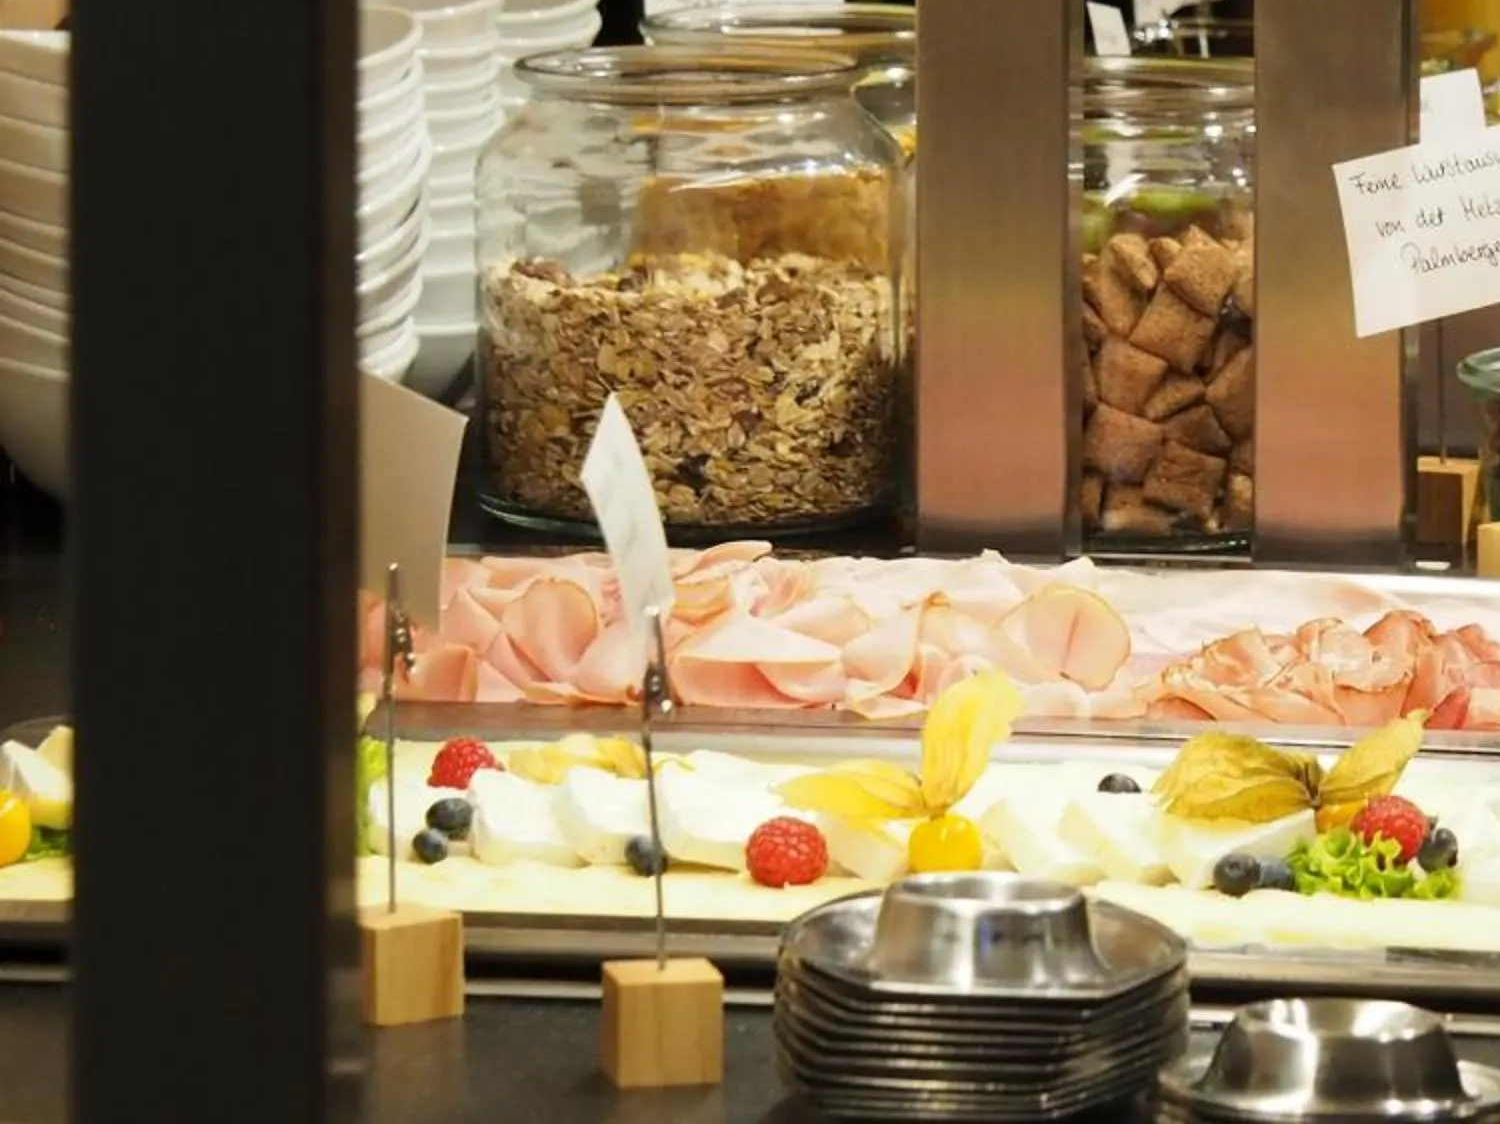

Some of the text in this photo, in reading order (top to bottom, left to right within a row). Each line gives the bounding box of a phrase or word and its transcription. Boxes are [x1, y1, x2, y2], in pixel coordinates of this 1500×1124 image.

[1348, 173, 1402, 195] Feine
[1376, 218, 1405, 237] von
[1416, 205, 1445, 227] der
